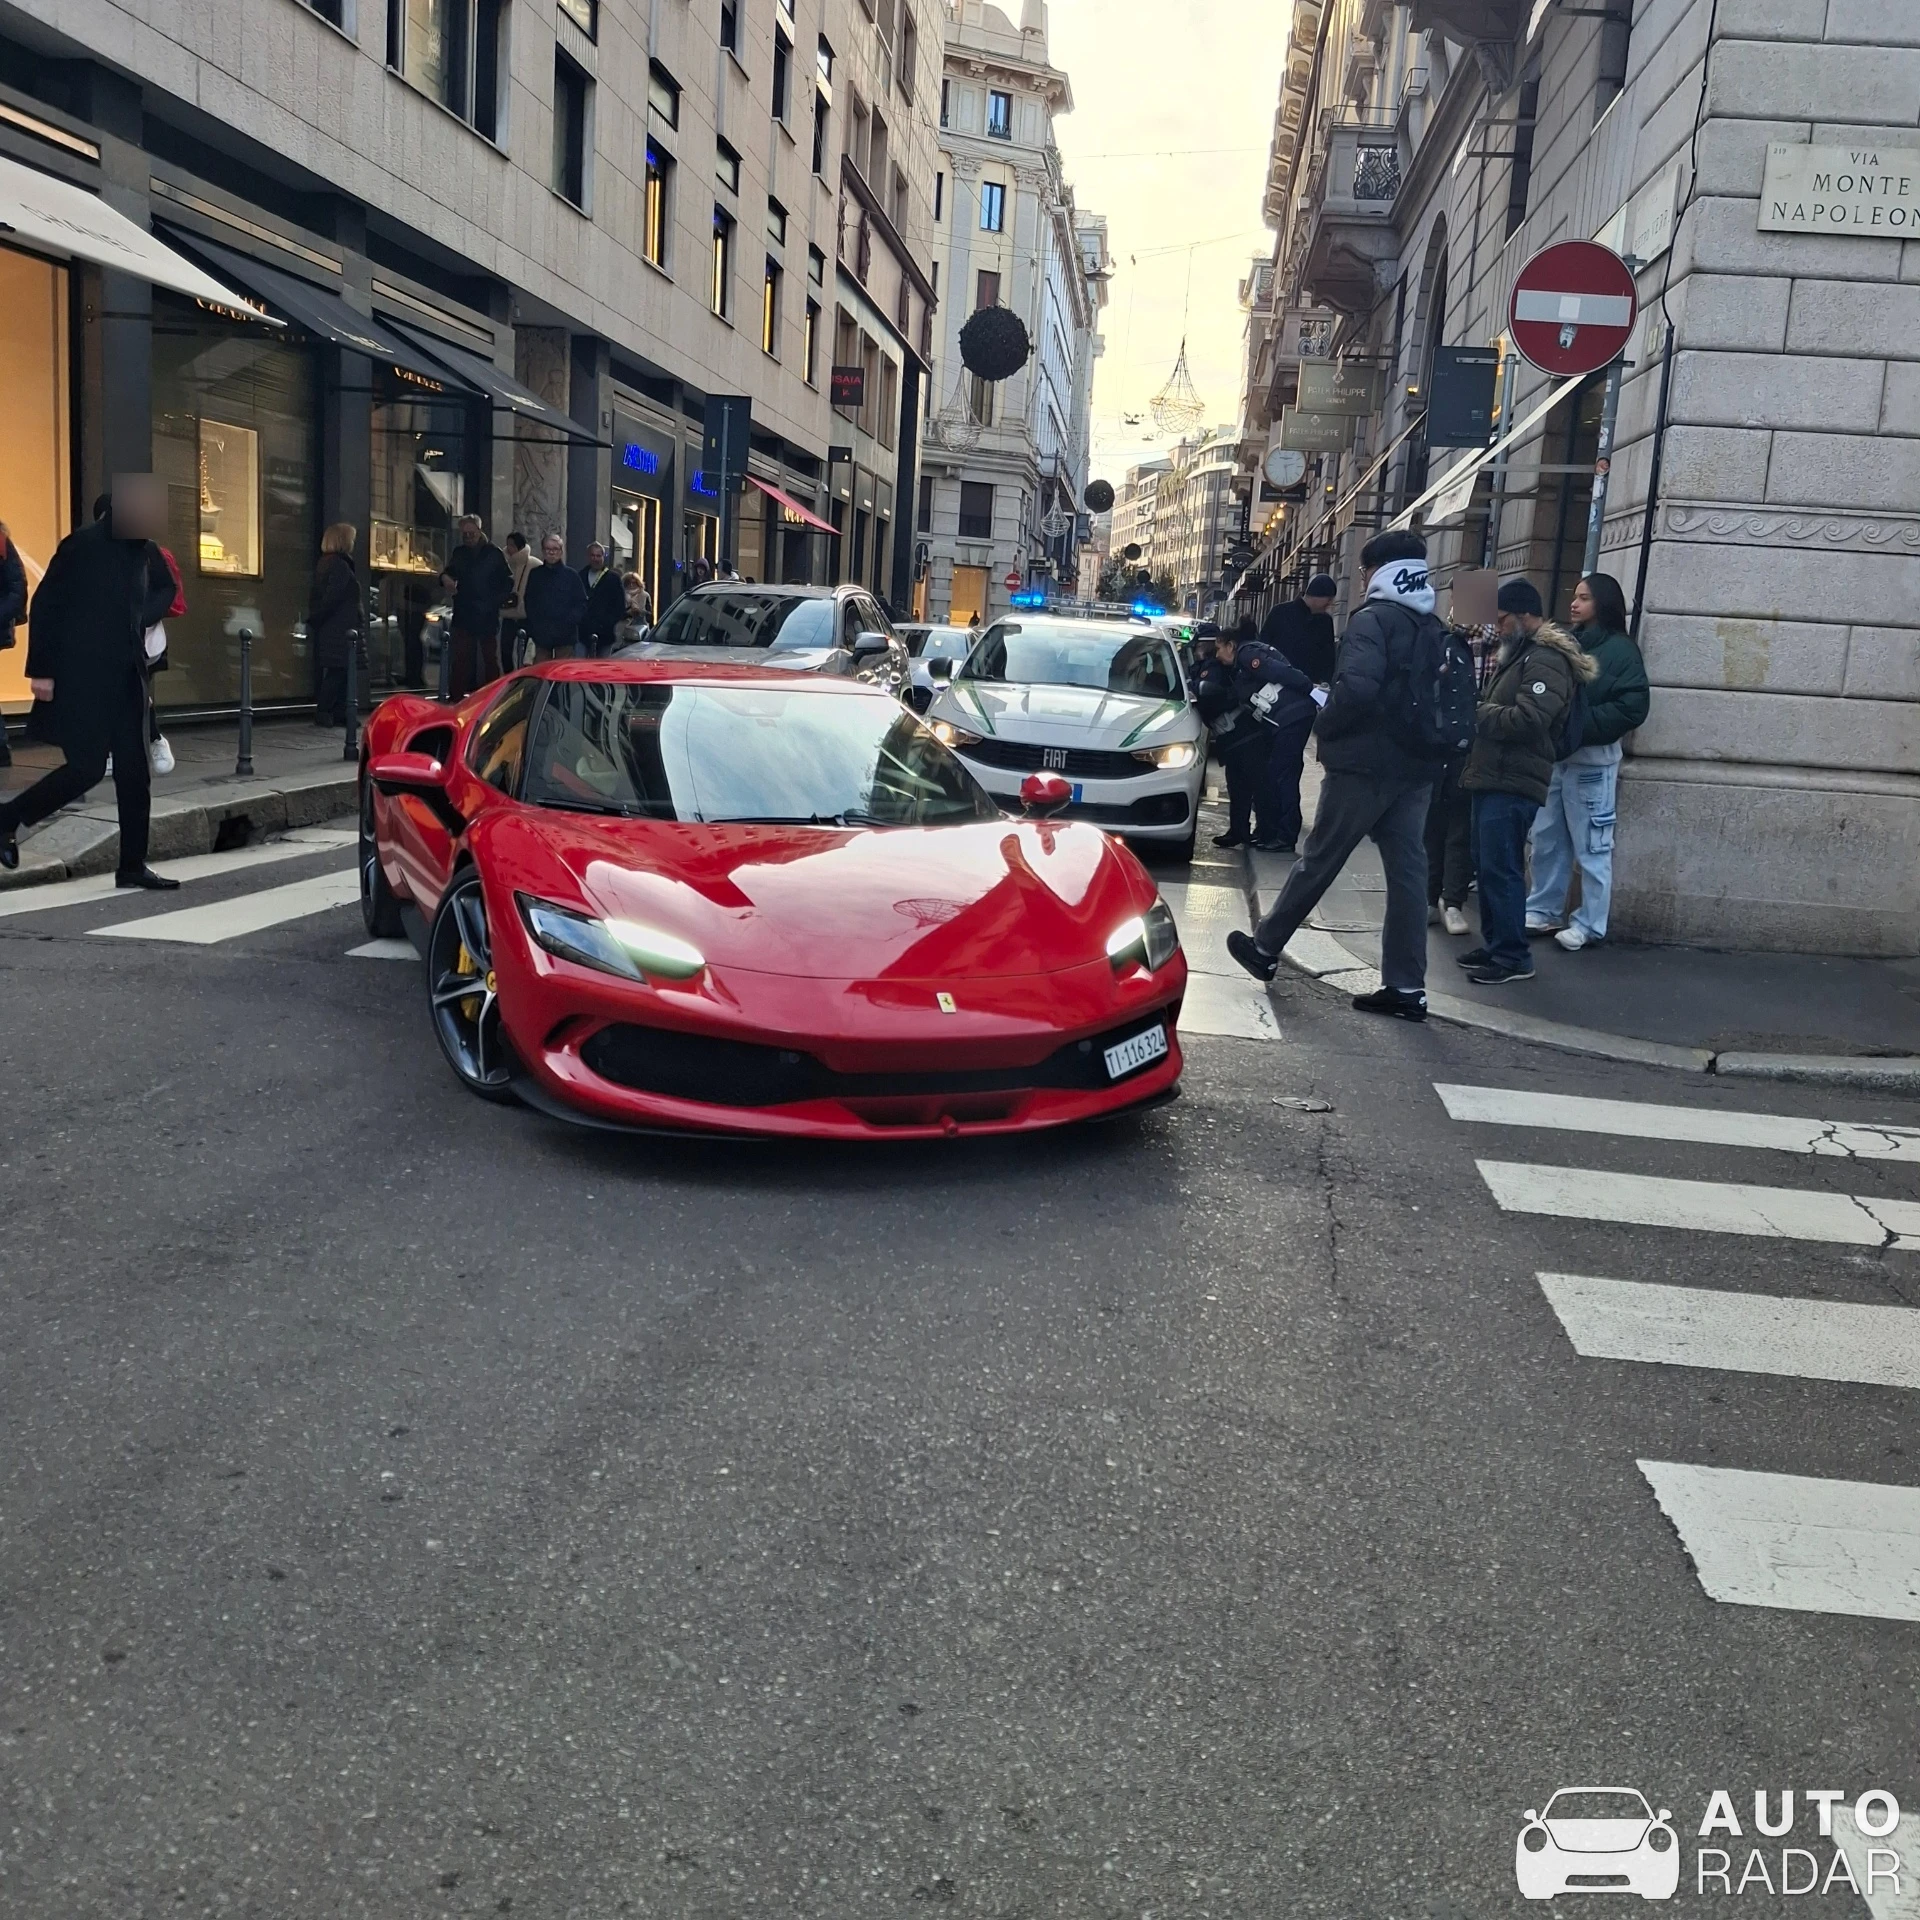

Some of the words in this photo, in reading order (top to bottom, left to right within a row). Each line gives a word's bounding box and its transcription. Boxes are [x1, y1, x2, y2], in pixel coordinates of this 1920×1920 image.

[1850, 152, 1880, 166] VIA
[1811, 173, 1912, 196] MONTE
[832, 374, 862, 385] ISAIA
[1307, 386, 1331, 396] PATEK
[1332, 387, 1367, 397] PHILIPPE
[1310, 428, 1340, 437] PHILIPPE
[1043, 748, 1069, 770] FIAT
